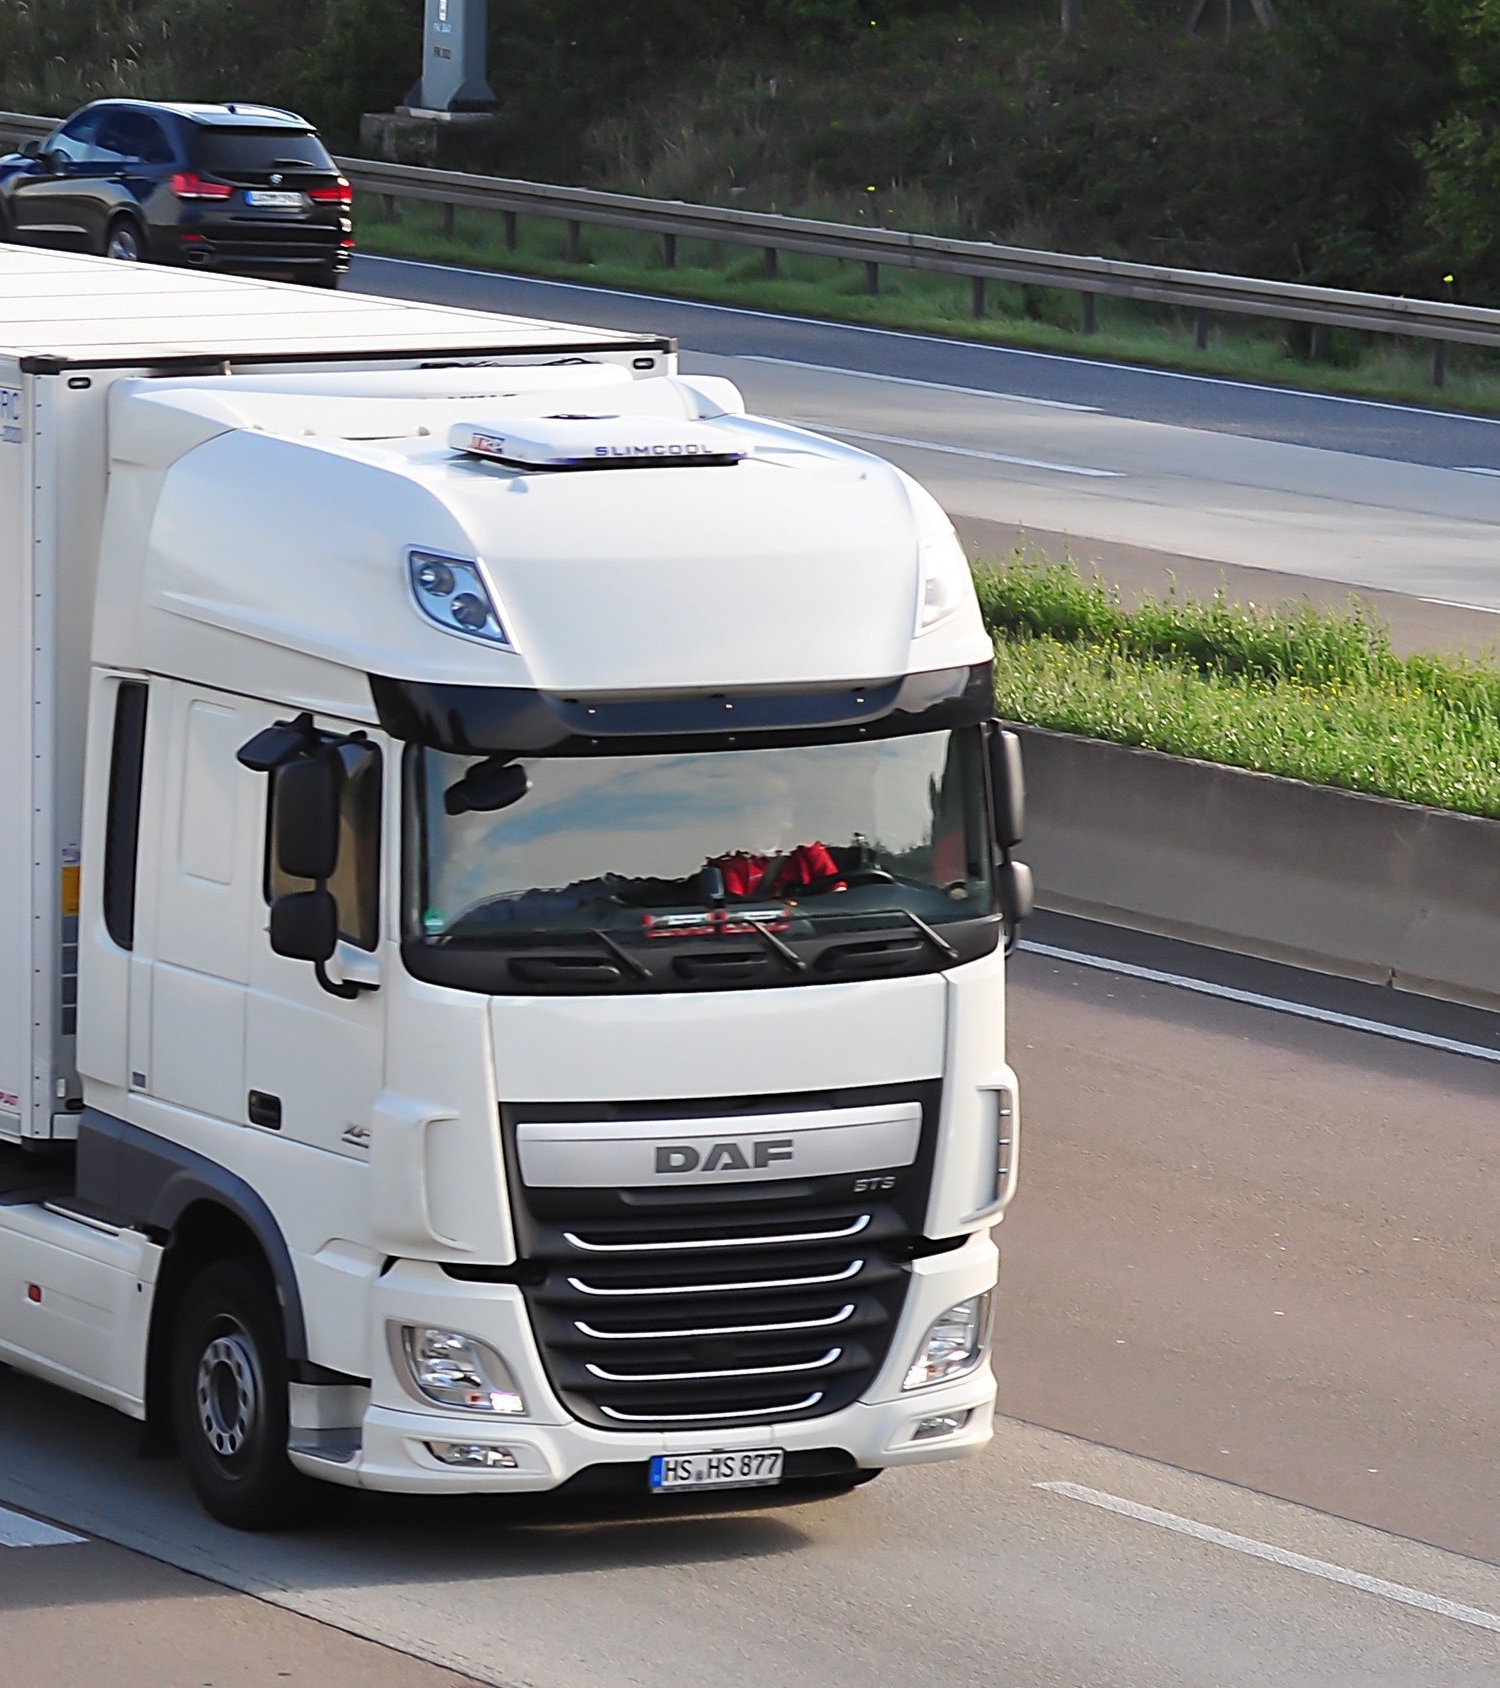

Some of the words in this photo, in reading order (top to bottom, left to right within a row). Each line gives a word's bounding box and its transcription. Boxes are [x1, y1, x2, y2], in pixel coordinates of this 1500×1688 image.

[595, 443, 714, 457] SLIMCOOL
[655, 1139, 794, 1174] DAF
[664, 1459, 692, 1482] HS
[707, 1456, 736, 1479] HS
[740, 1453, 781, 1477] 877
